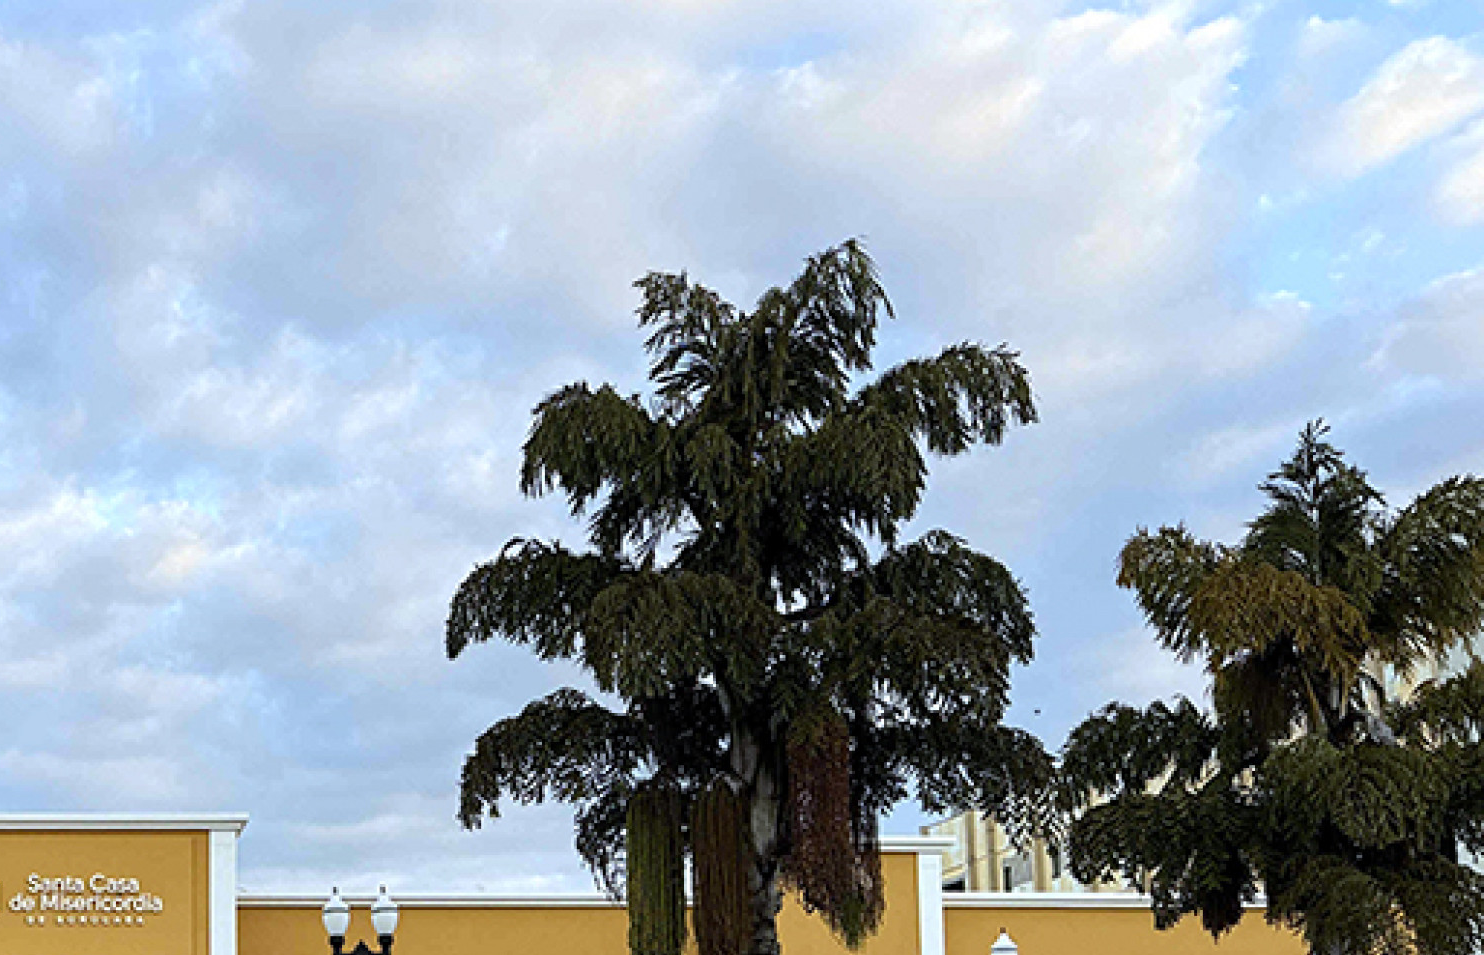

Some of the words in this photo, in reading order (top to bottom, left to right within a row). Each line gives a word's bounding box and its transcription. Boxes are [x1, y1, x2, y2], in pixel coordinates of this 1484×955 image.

[27, 872, 84, 893] Santa
[89, 872, 140, 893] Casa
[8, 893, 35, 911] de
[40, 893, 163, 911] Misericordia
